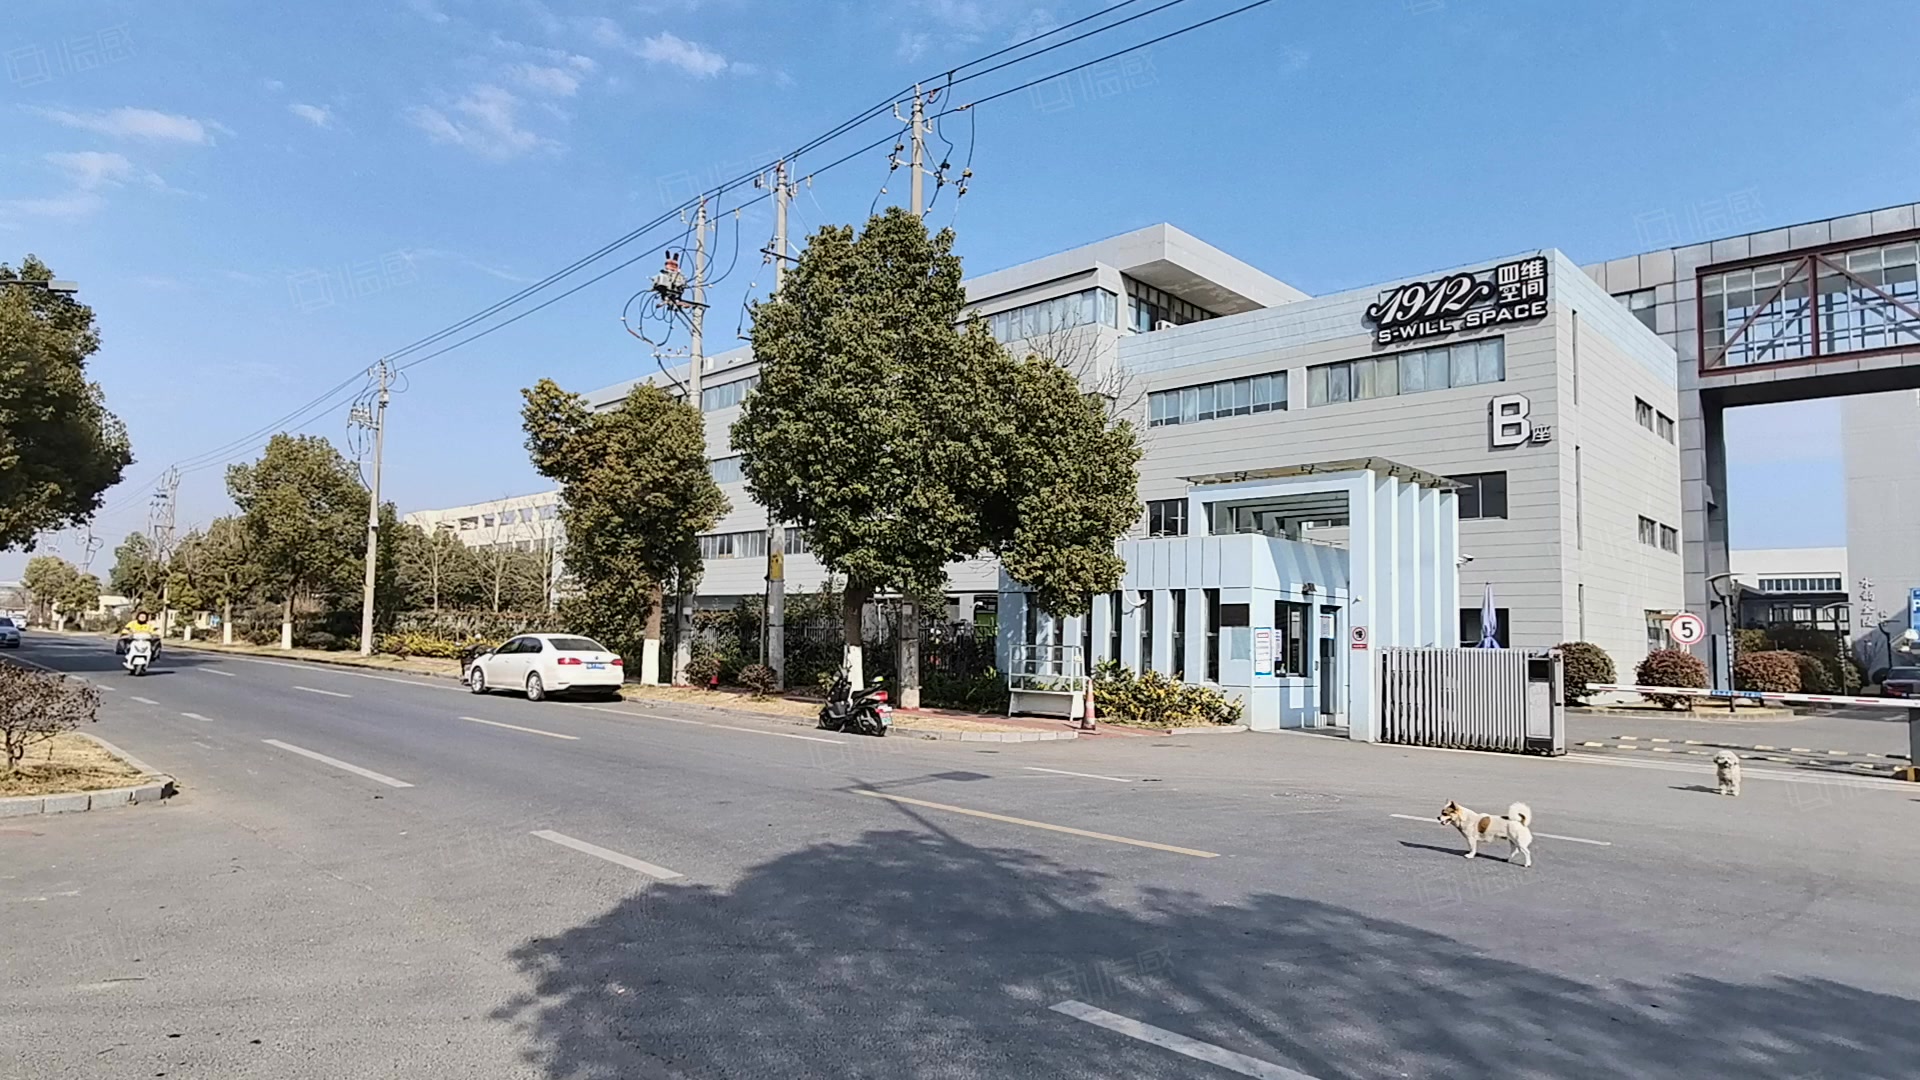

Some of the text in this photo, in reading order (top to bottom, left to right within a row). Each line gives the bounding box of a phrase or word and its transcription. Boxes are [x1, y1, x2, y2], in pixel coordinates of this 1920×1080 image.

[1370, 275, 1491, 325] 1912
[1499, 279, 1545, 304] 空间
[1378, 300, 1547, 344] S-WILL SPACE
[1681, 621, 1693, 639] 5
